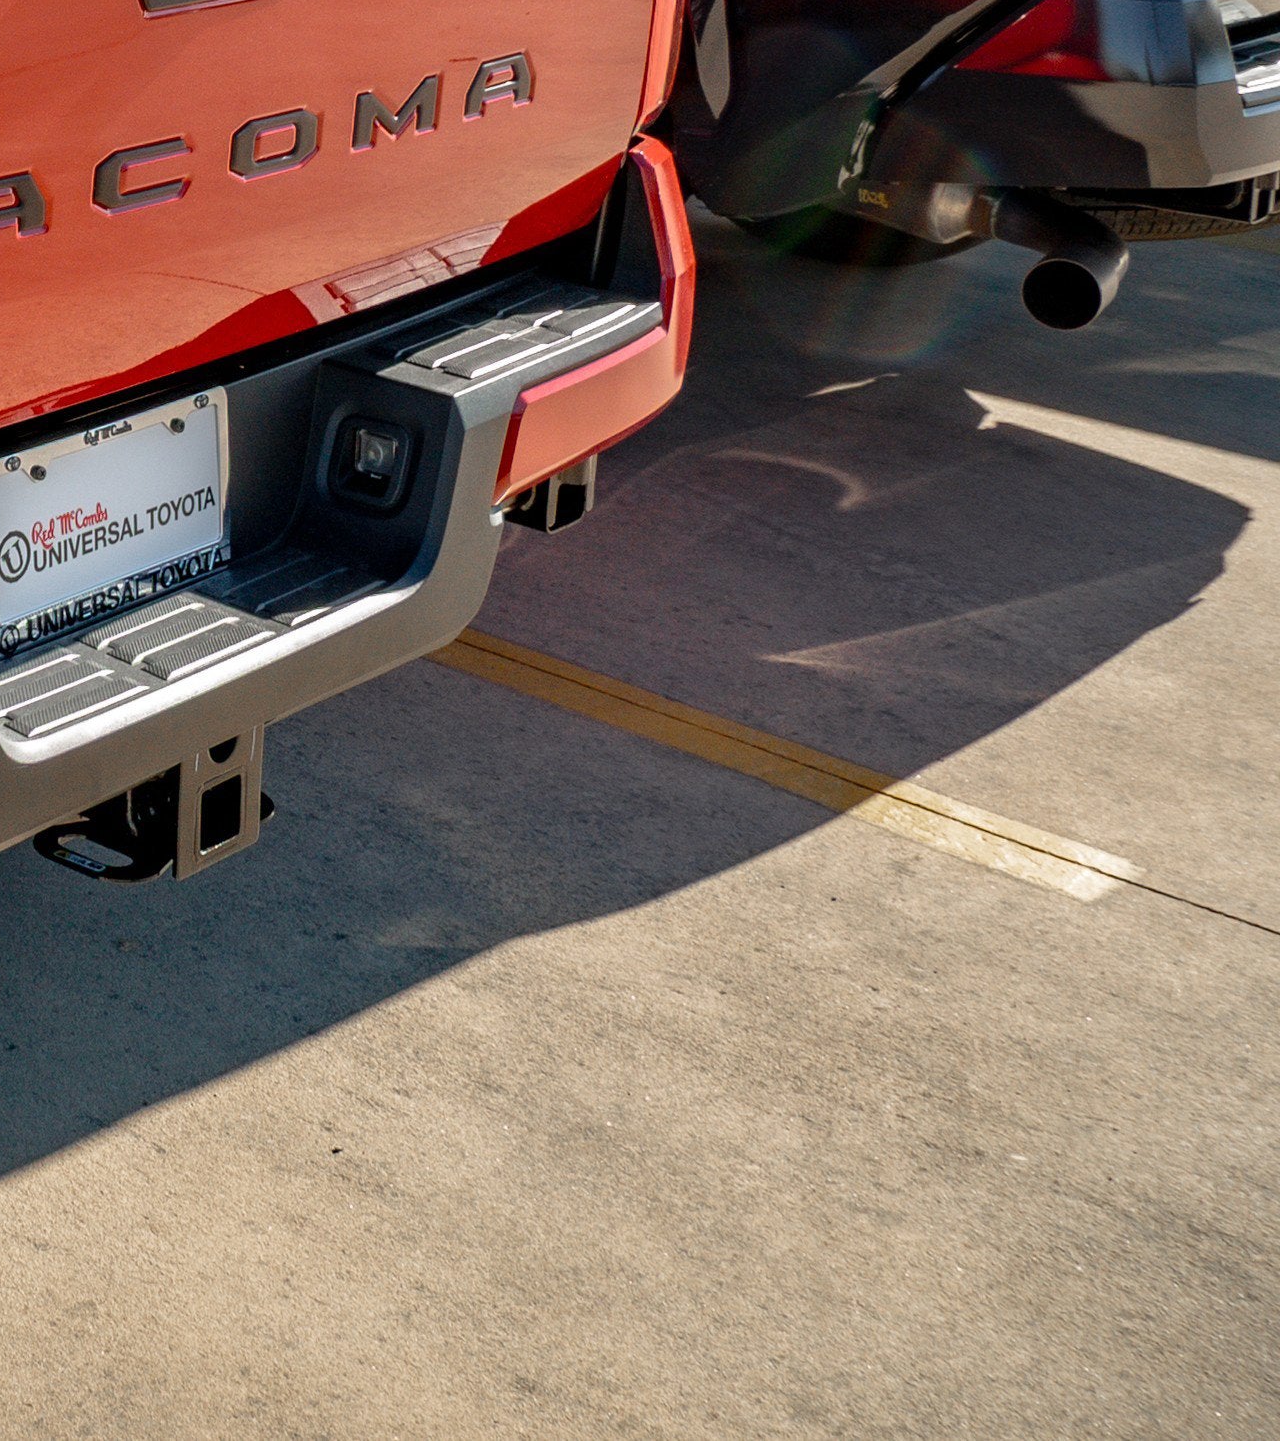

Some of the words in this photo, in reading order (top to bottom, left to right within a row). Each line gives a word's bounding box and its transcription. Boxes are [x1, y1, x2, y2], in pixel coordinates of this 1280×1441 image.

[32, 521, 55, 550] Red
[56, 501, 107, 535] McCombs
[33, 513, 144, 572] UNIVERSAL
[146, 486, 215, 530] TOYOTA
[27, 576, 145, 641] UNIVERSAL
[146, 547, 224, 594] TOYOTA
